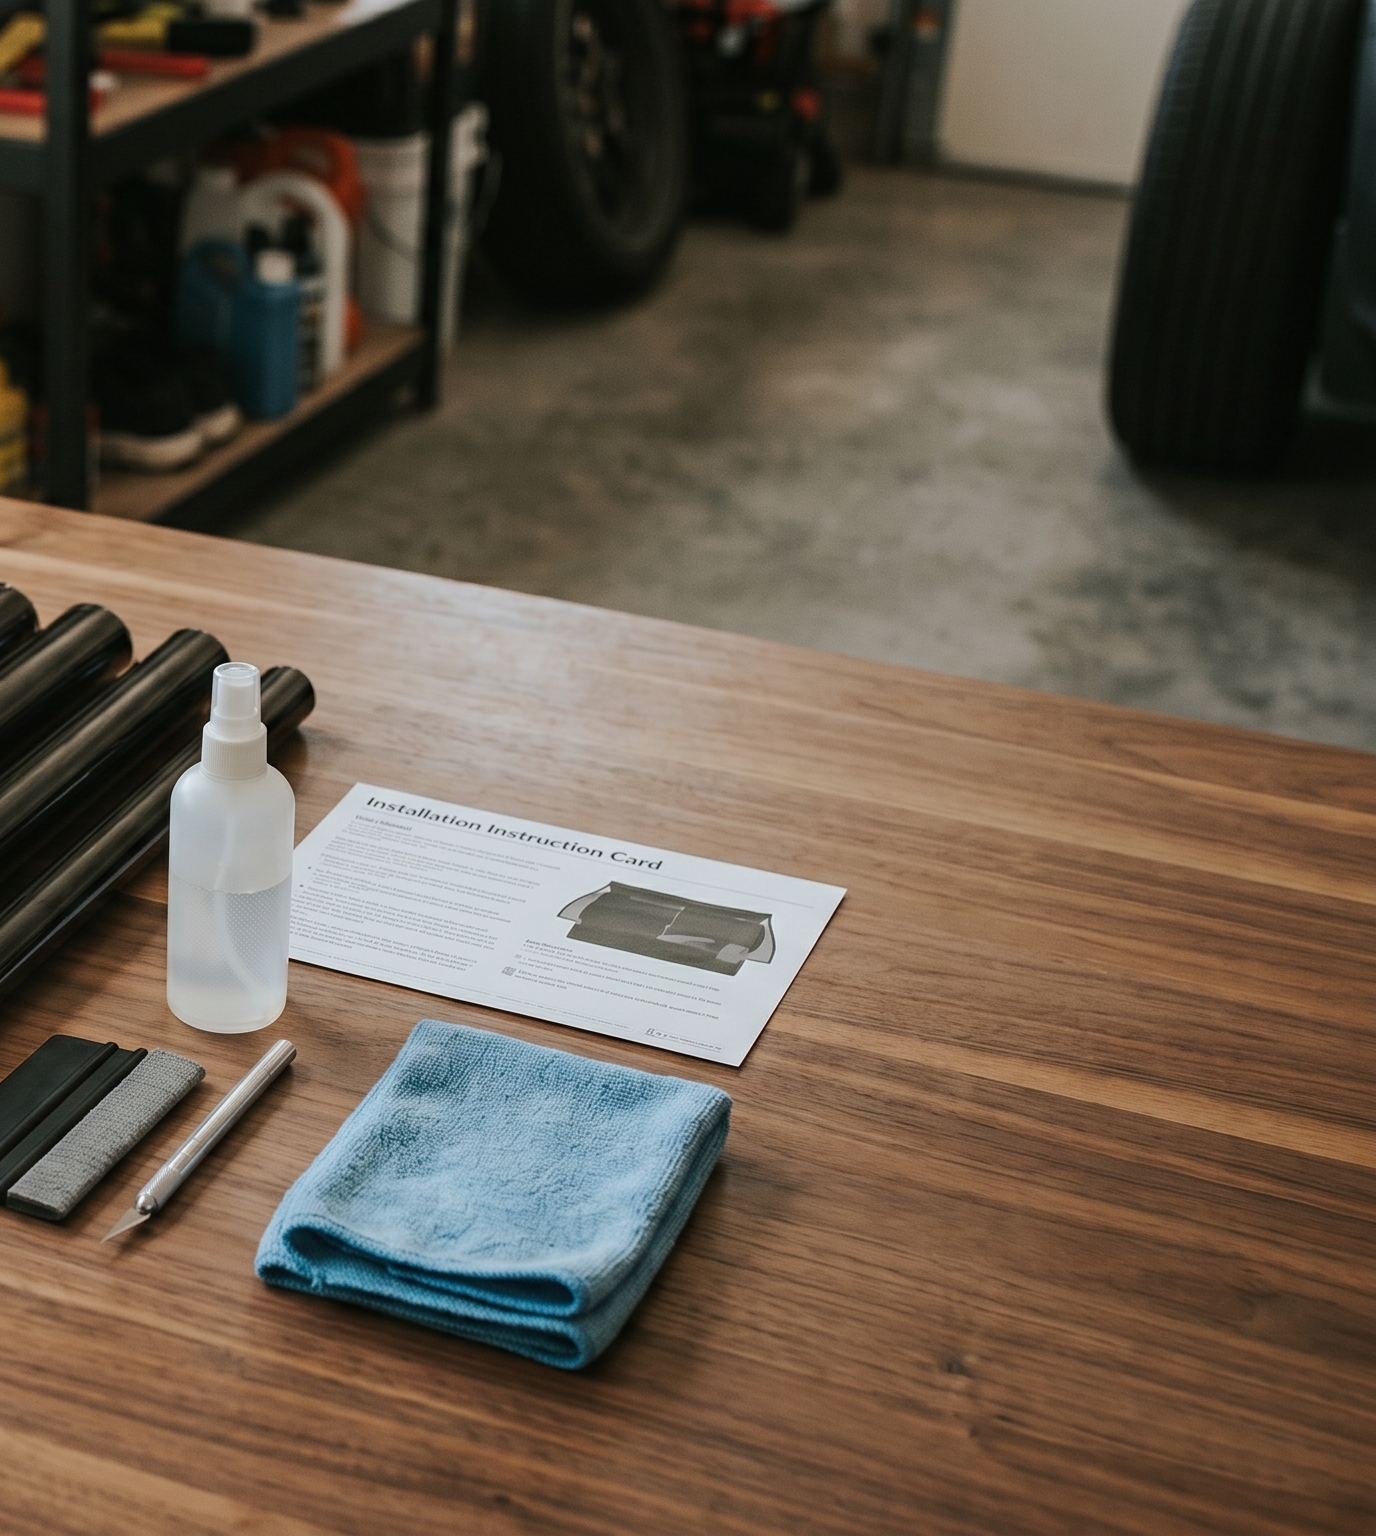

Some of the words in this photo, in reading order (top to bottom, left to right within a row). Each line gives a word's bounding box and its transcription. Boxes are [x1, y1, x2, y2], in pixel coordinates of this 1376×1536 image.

[366, 797, 481, 832] Installation
[487, 824, 603, 858] Instruction
[610, 851, 663, 871] Card
